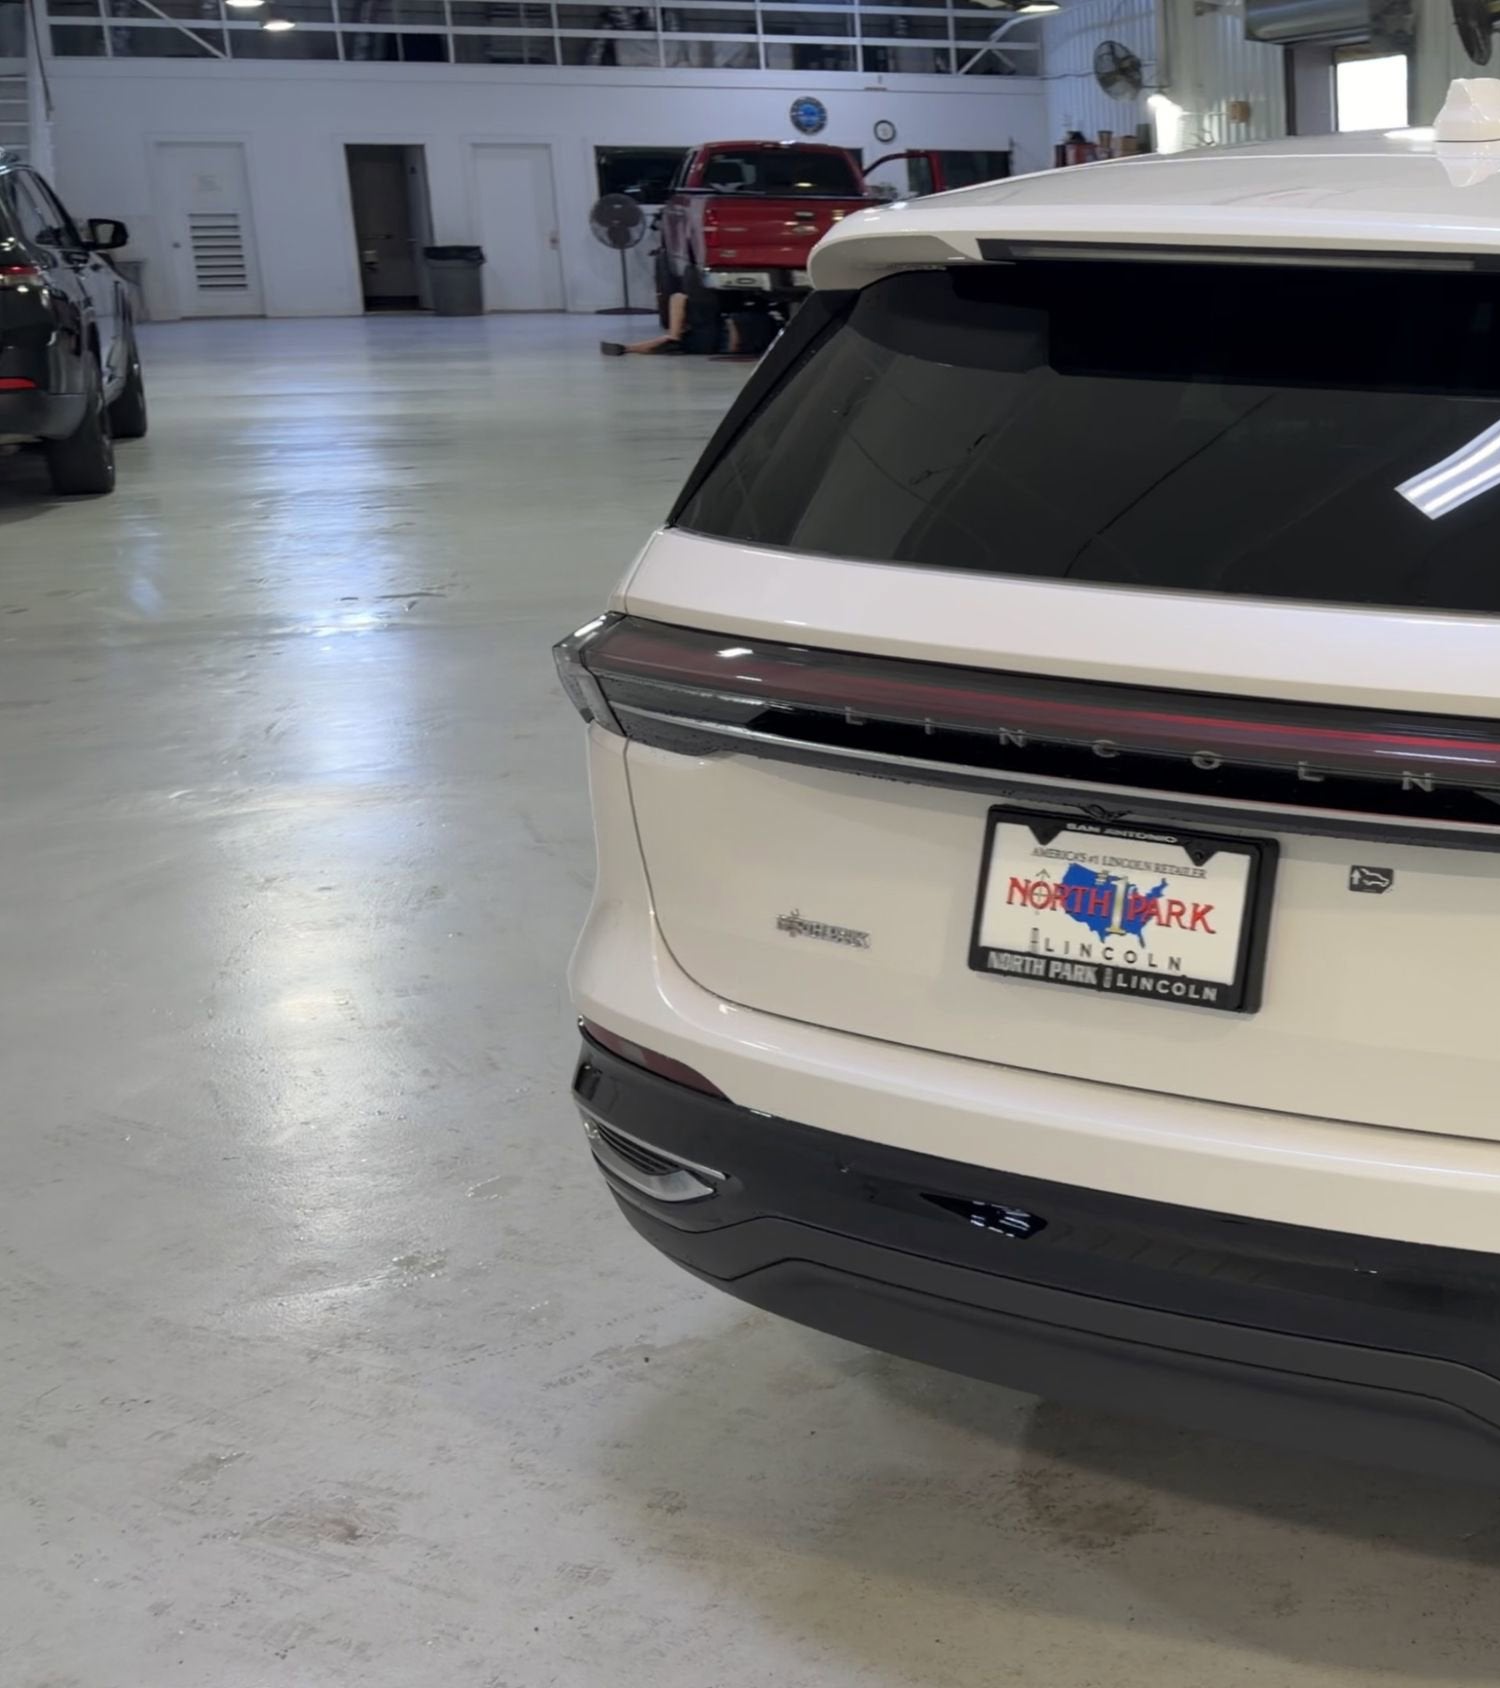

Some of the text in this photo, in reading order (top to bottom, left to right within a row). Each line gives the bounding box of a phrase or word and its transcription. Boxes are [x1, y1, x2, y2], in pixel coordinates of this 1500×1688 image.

[845, 705, 1435, 791] LINCOLN
[1066, 823, 1179, 843] SAN ANTONIO
[1102, 855, 1151, 873] LINCOLN
[1153, 861, 1208, 879] RETAILER
[1006, 876, 1112, 917] NORTH
[1126, 891, 1217, 935] PARK
[1044, 937, 1182, 971] LINCOLN
[986, 950, 1218, 1001] NORTH PARK LINCOLN
